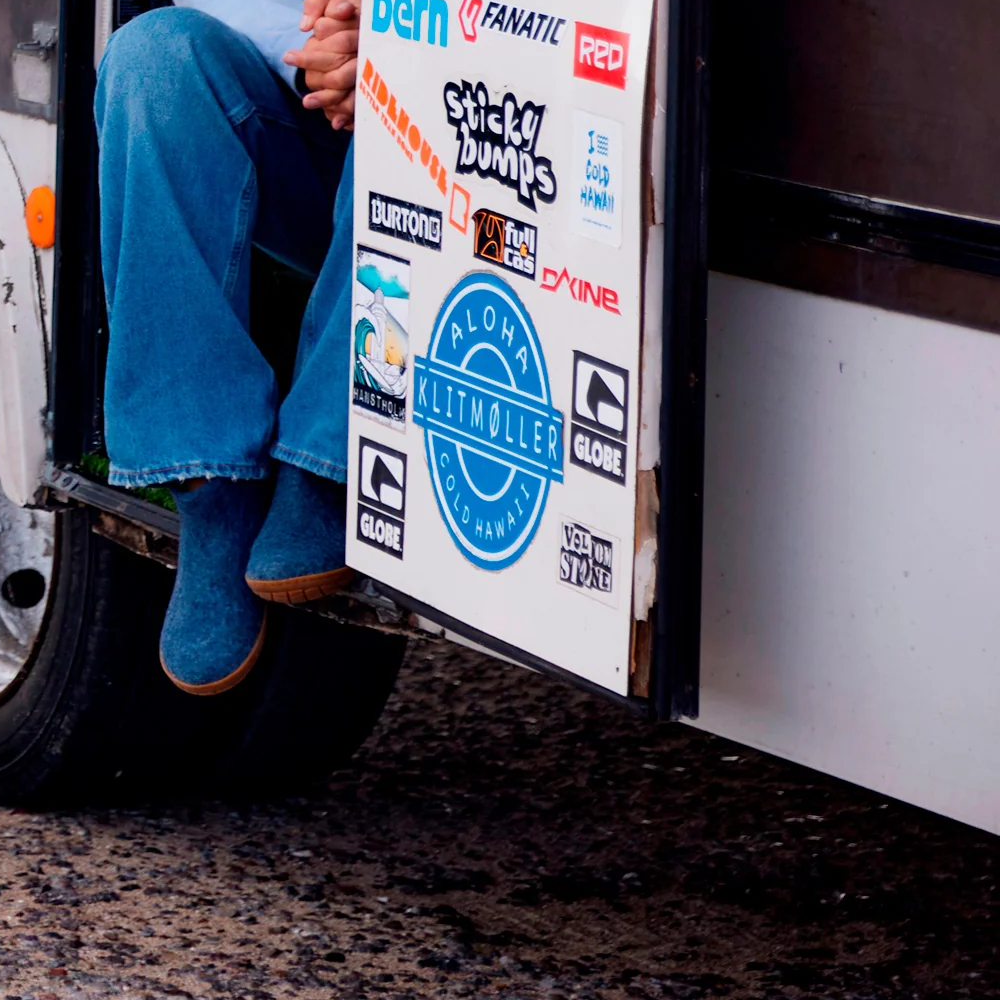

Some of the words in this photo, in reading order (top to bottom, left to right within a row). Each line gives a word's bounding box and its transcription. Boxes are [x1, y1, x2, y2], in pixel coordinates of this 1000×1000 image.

[481, 1, 566, 46] FANATIC
[459, 122, 554, 199] bumps
[585, 159, 610, 188] COLD
[371, 197, 431, 240] BURTON
[450, 305, 529, 375] ALOHA
[418, 375, 558, 462] KLITMØLLER
[574, 433, 622, 476] GLOBE
[440, 453, 471, 524] COLD
[475, 482, 531, 541] HAWAII
[360, 511, 402, 551] GLOBE
